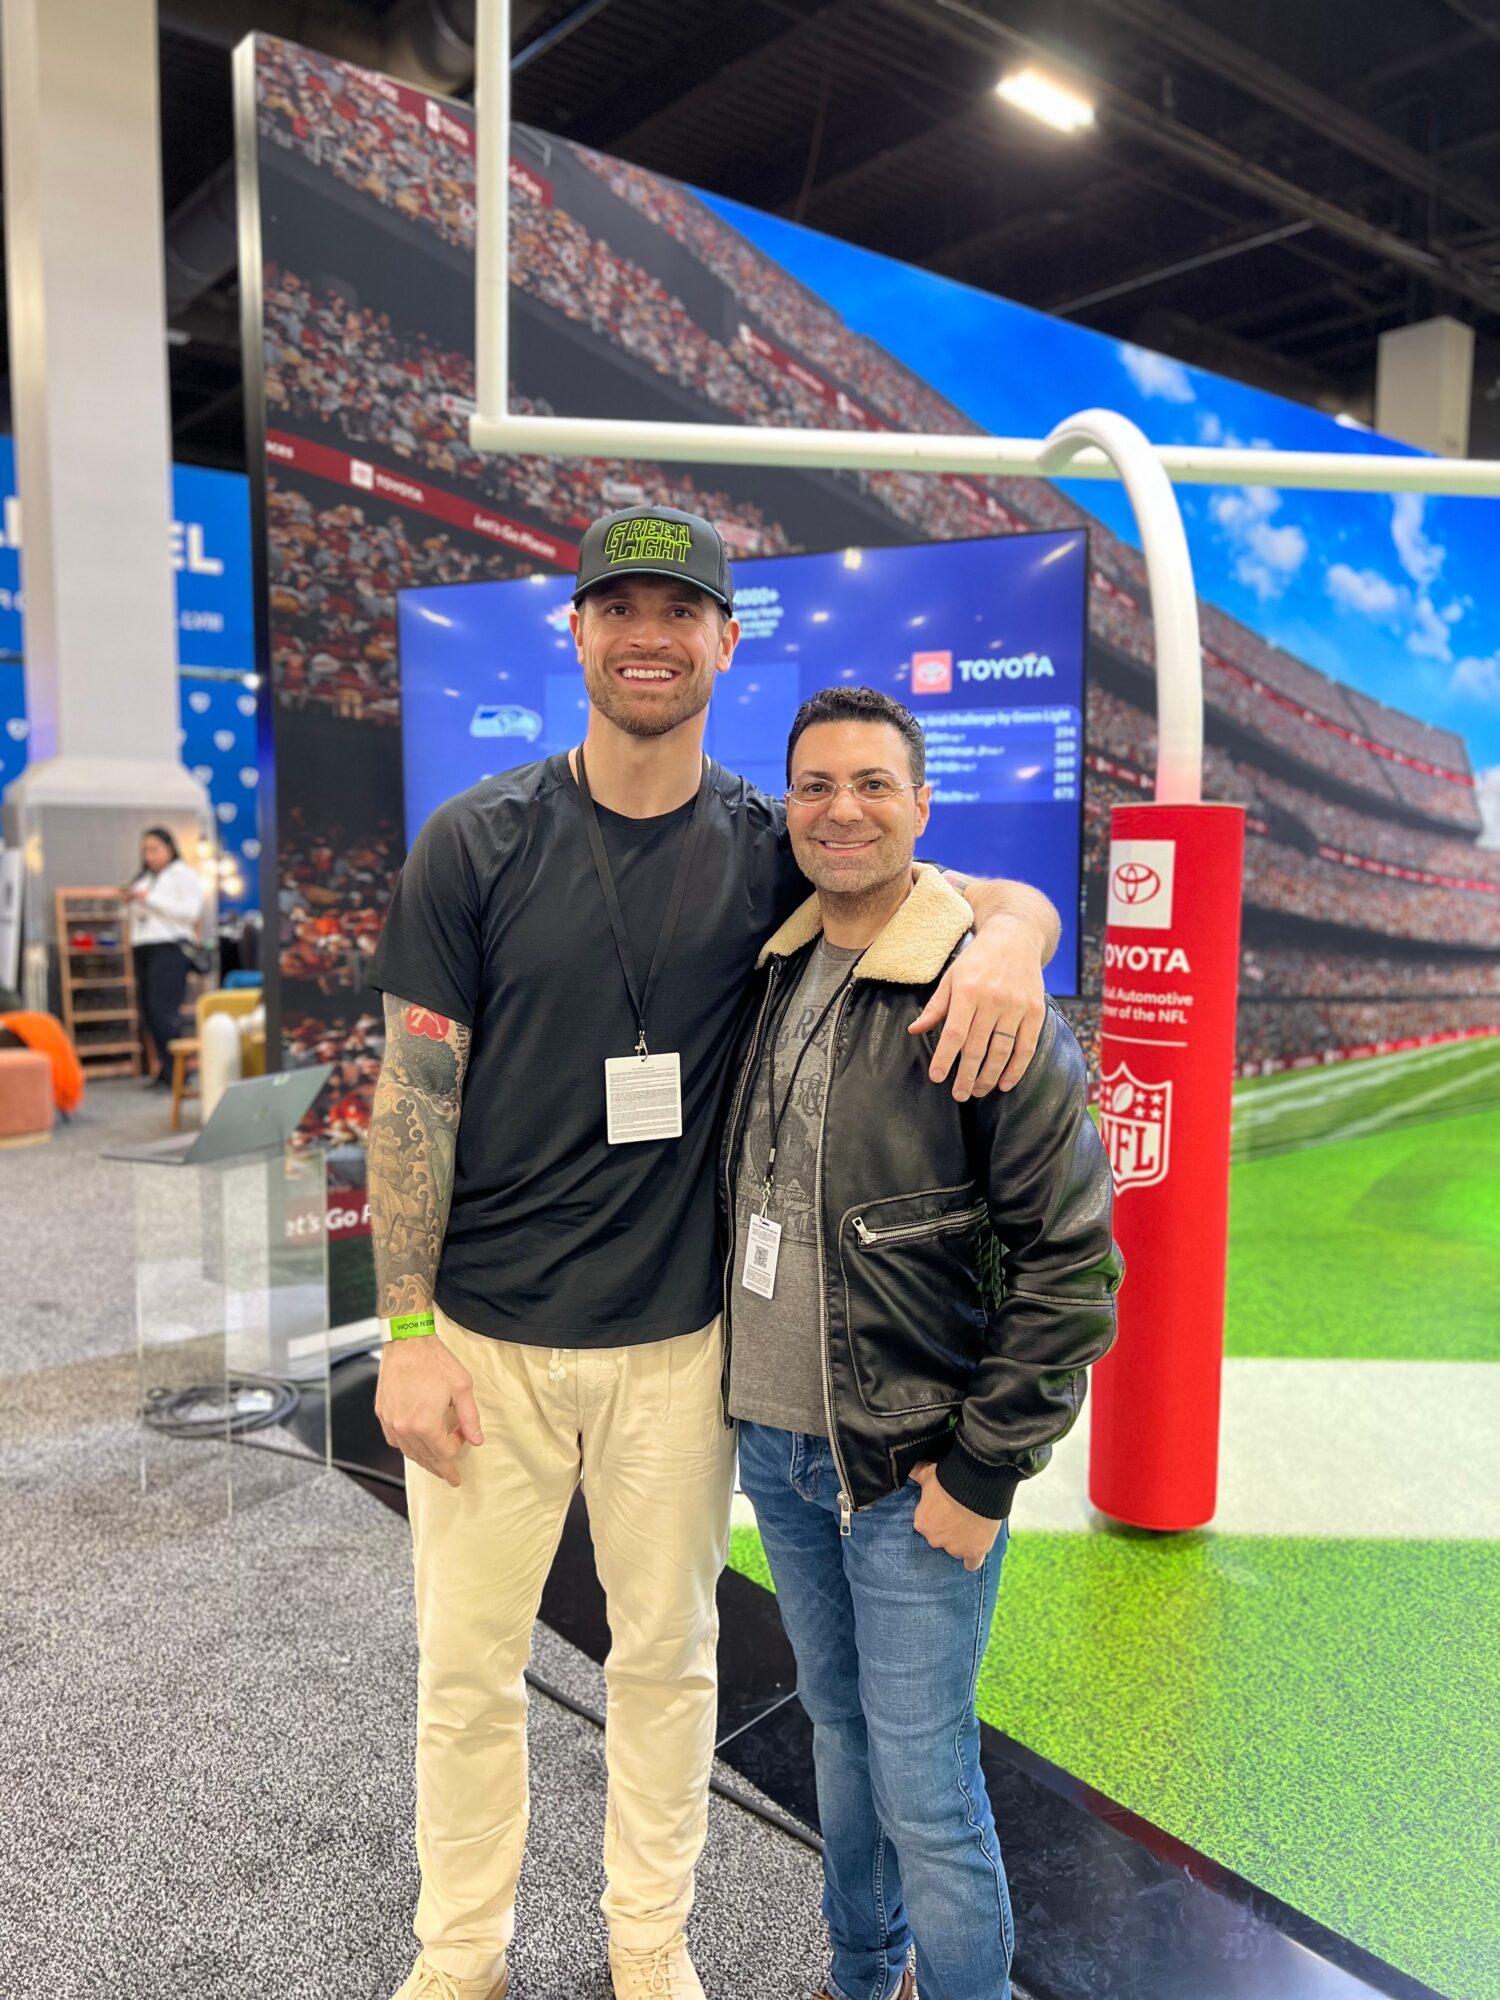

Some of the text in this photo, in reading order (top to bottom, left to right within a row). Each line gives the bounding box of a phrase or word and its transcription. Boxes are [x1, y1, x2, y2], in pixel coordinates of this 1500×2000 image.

[375, 473, 425, 503] TOYOTA
[605, 519, 692, 553] GREEN
[610, 533, 692, 563] LIGHT
[957, 655, 1056, 682] TOYOTA
[1043, 709, 1071, 724] Light
[1104, 943, 1191, 973] OYOTA
[1116, 987, 1194, 1007] Automotive
[1119, 1005, 1132, 1019] of
[1132, 1007, 1156, 1023] the
[1158, 1008, 1188, 1025] NFL
[285, 1212, 321, 1238] et's
[325, 1207, 359, 1230] Go
[397, 1321, 419, 1331] ROOM
